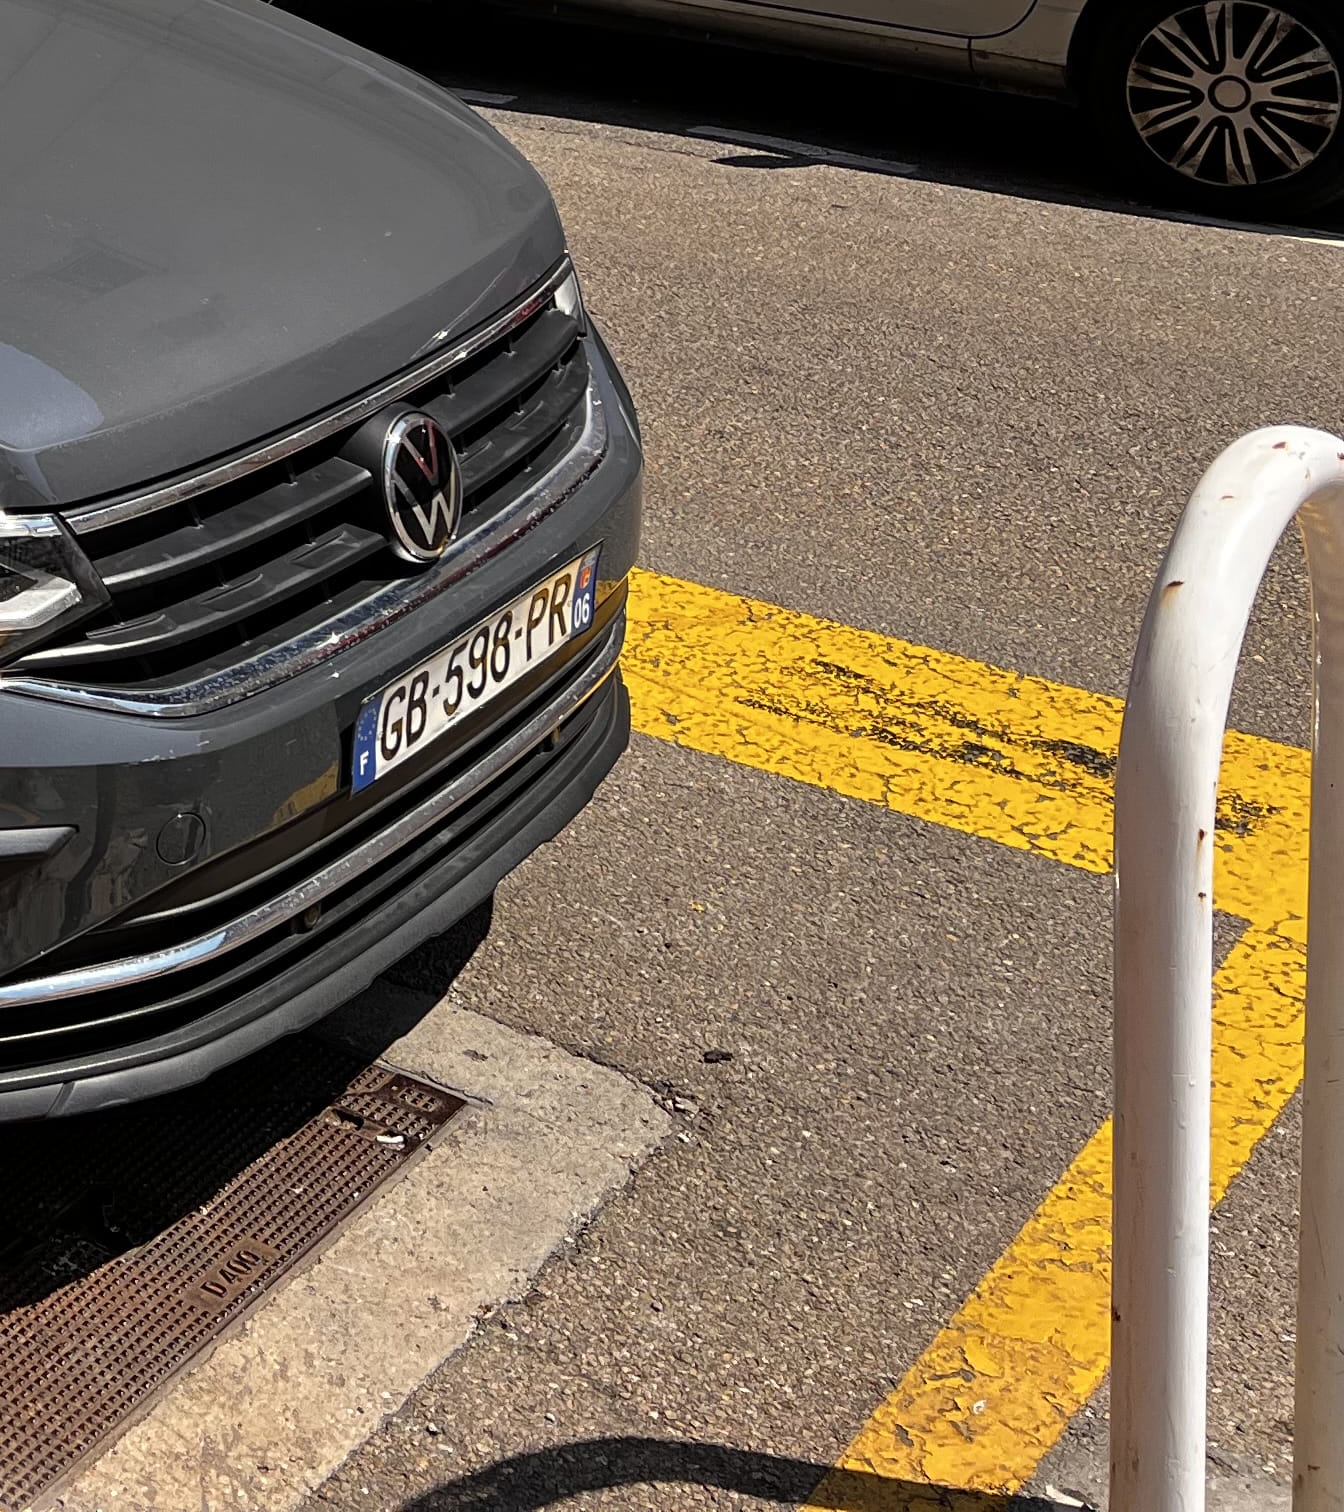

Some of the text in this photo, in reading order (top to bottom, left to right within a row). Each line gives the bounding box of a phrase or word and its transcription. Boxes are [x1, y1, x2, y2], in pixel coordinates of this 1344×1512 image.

[573, 592, 591, 630] 06
[379, 571, 573, 762] GB-598-PR
[358, 750, 370, 777] F
